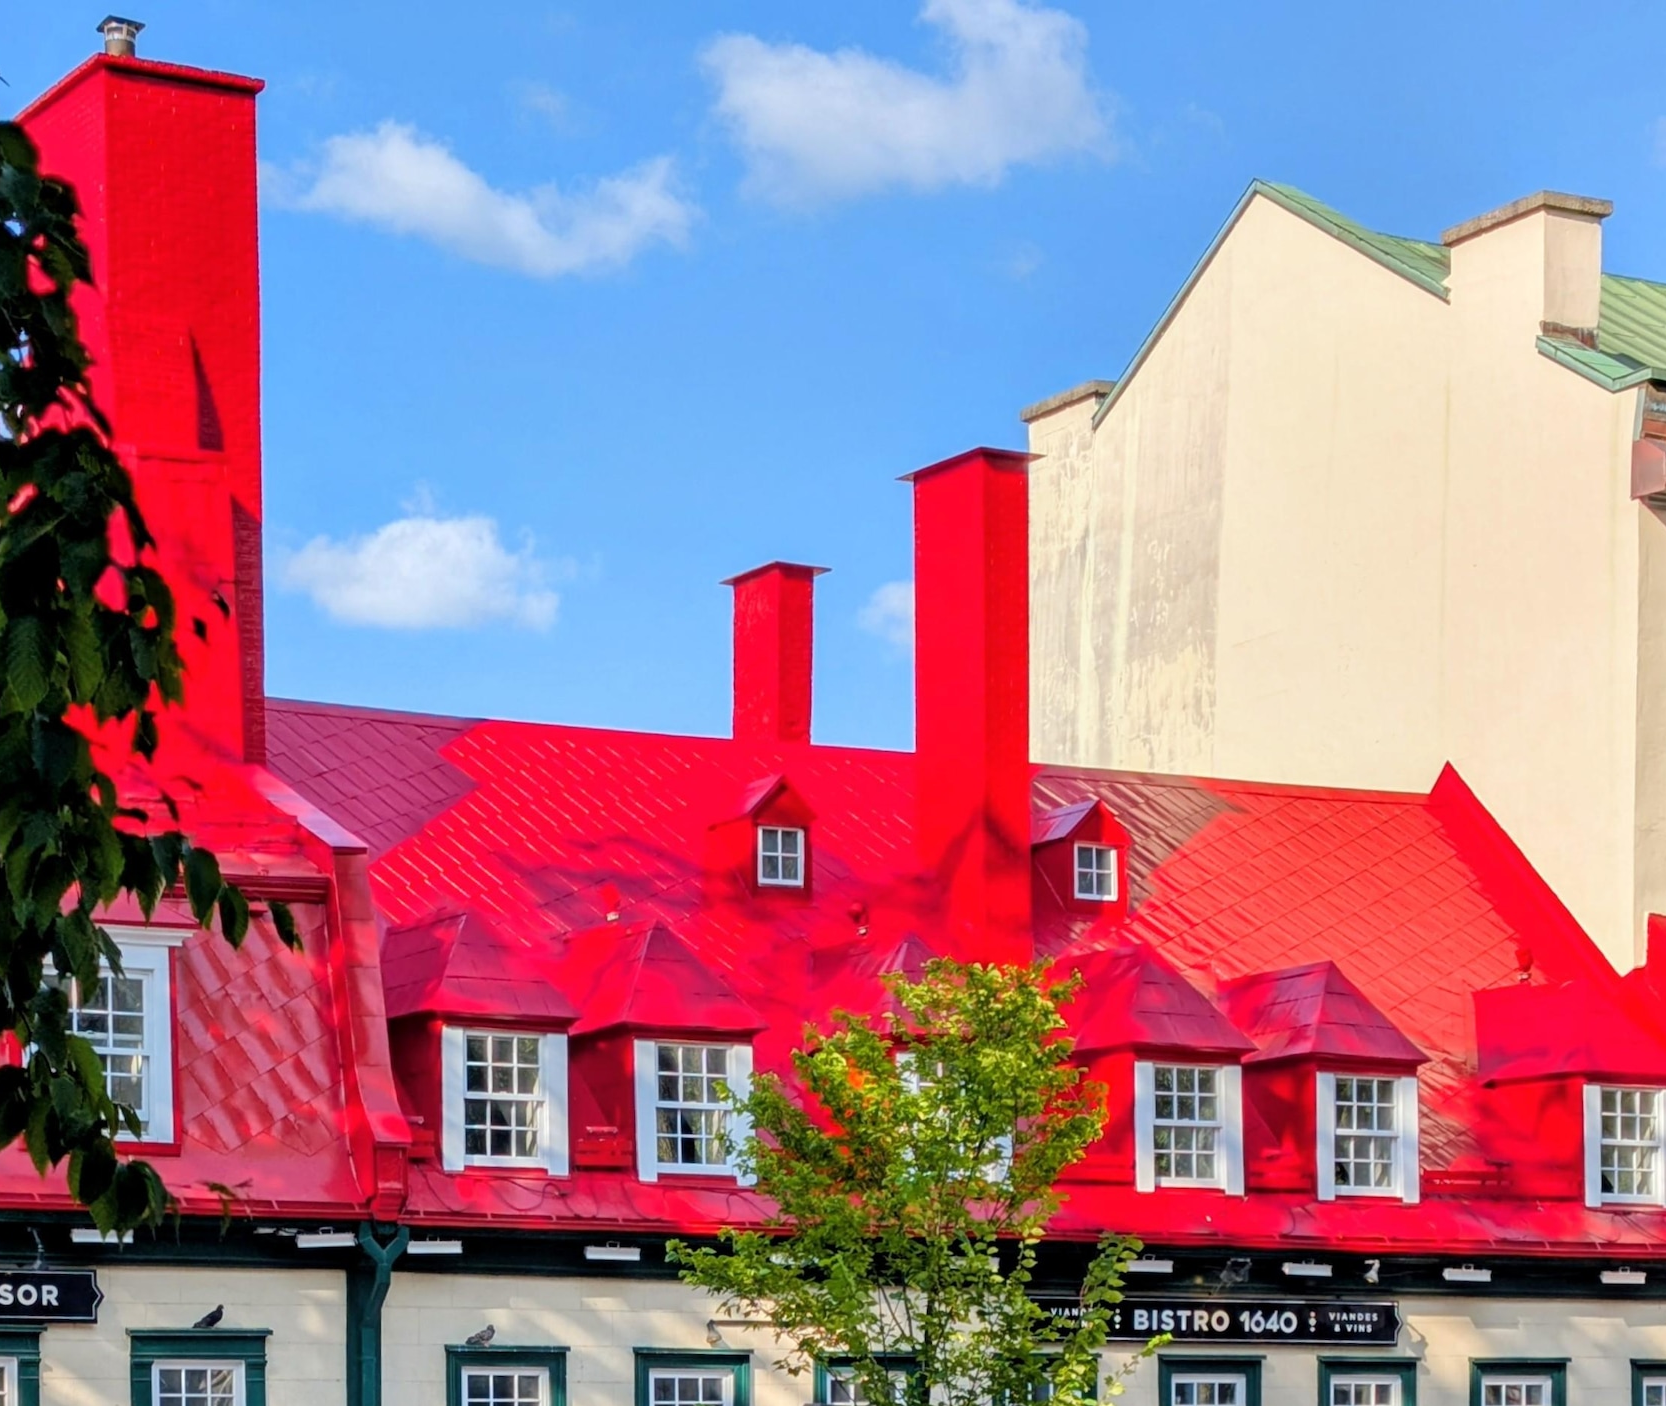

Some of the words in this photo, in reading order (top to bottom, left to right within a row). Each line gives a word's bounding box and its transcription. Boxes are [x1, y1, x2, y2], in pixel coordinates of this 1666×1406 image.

[1133, 1309, 1230, 1332] BISTRO
[1239, 1310, 1298, 1334] 1640
[1328, 1312, 1379, 1322] VIANDES
[1345, 1324, 1373, 1334] VINS
